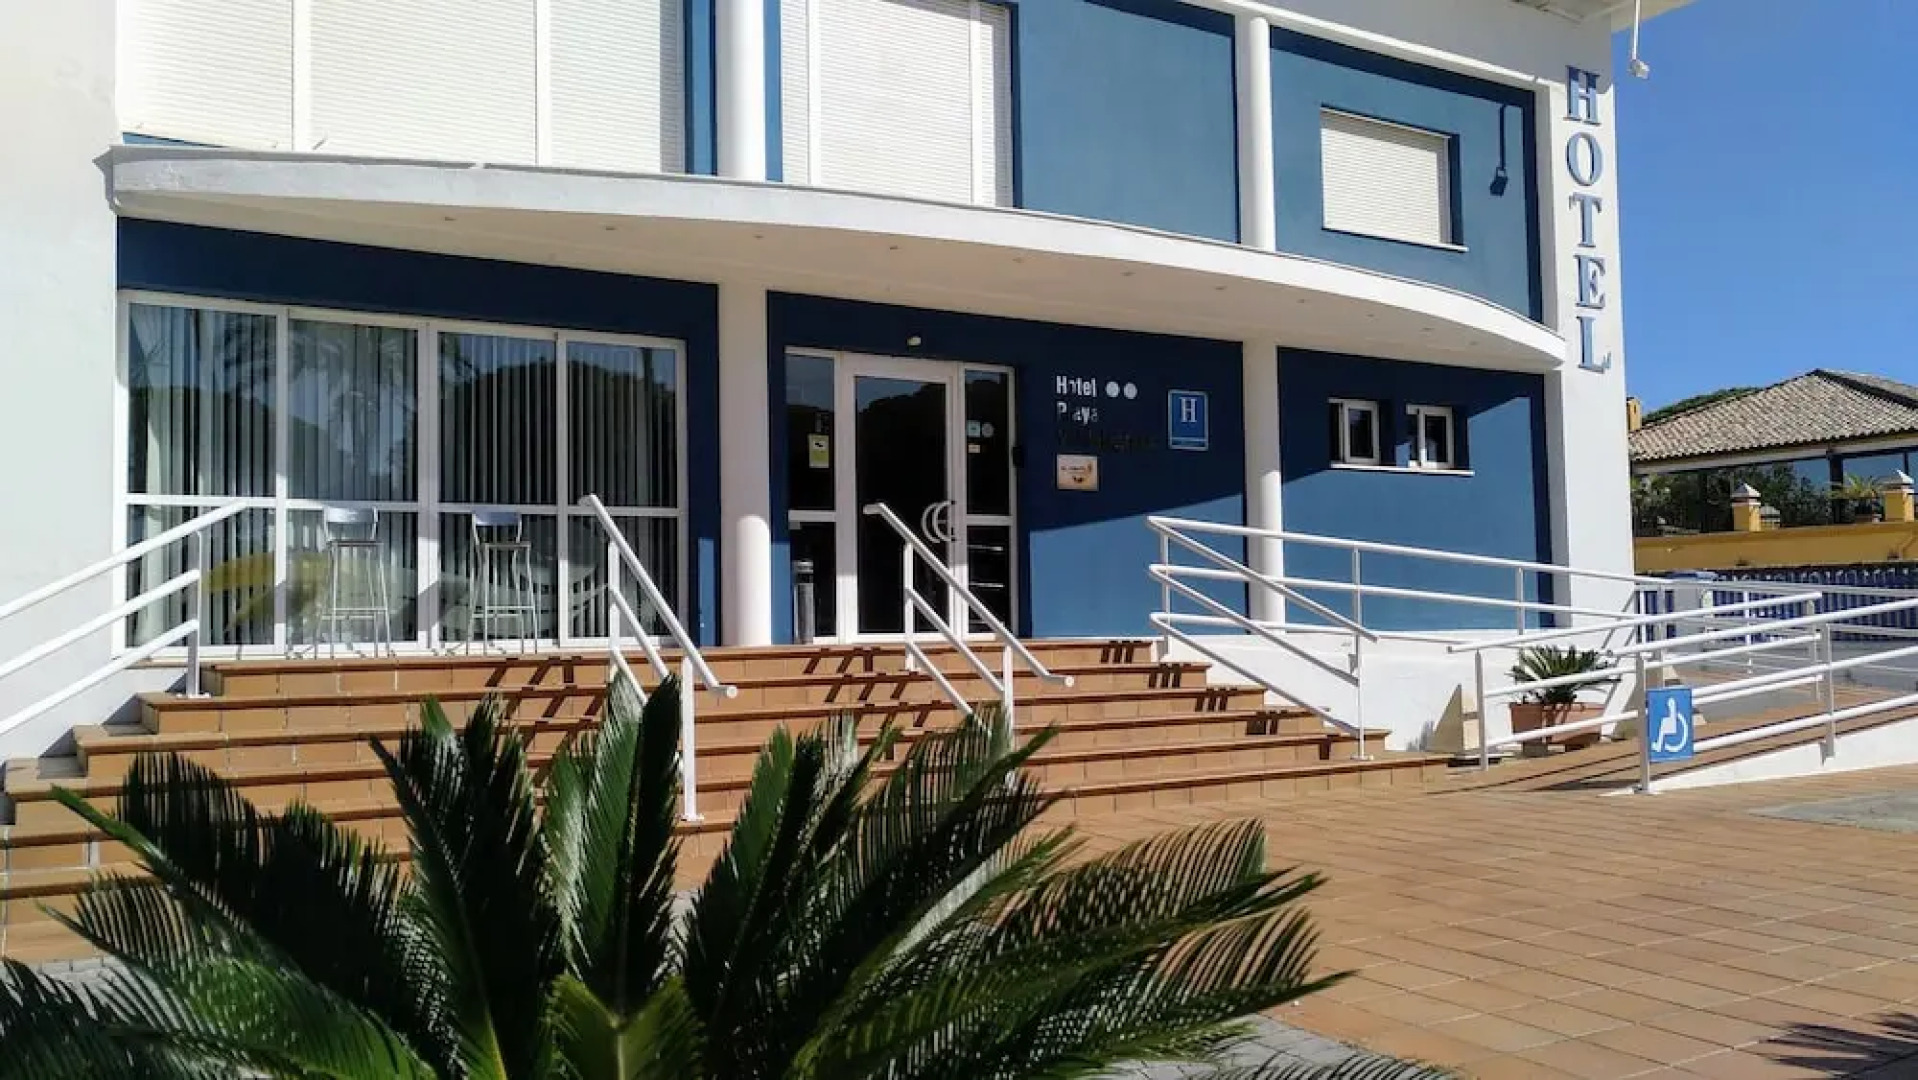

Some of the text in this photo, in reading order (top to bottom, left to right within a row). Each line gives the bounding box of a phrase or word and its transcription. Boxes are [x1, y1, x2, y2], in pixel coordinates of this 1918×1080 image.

[1563, 65, 1612, 374] HOTEL
[1056, 401, 1098, 425] Paya
[1179, 397, 1198, 423] H
